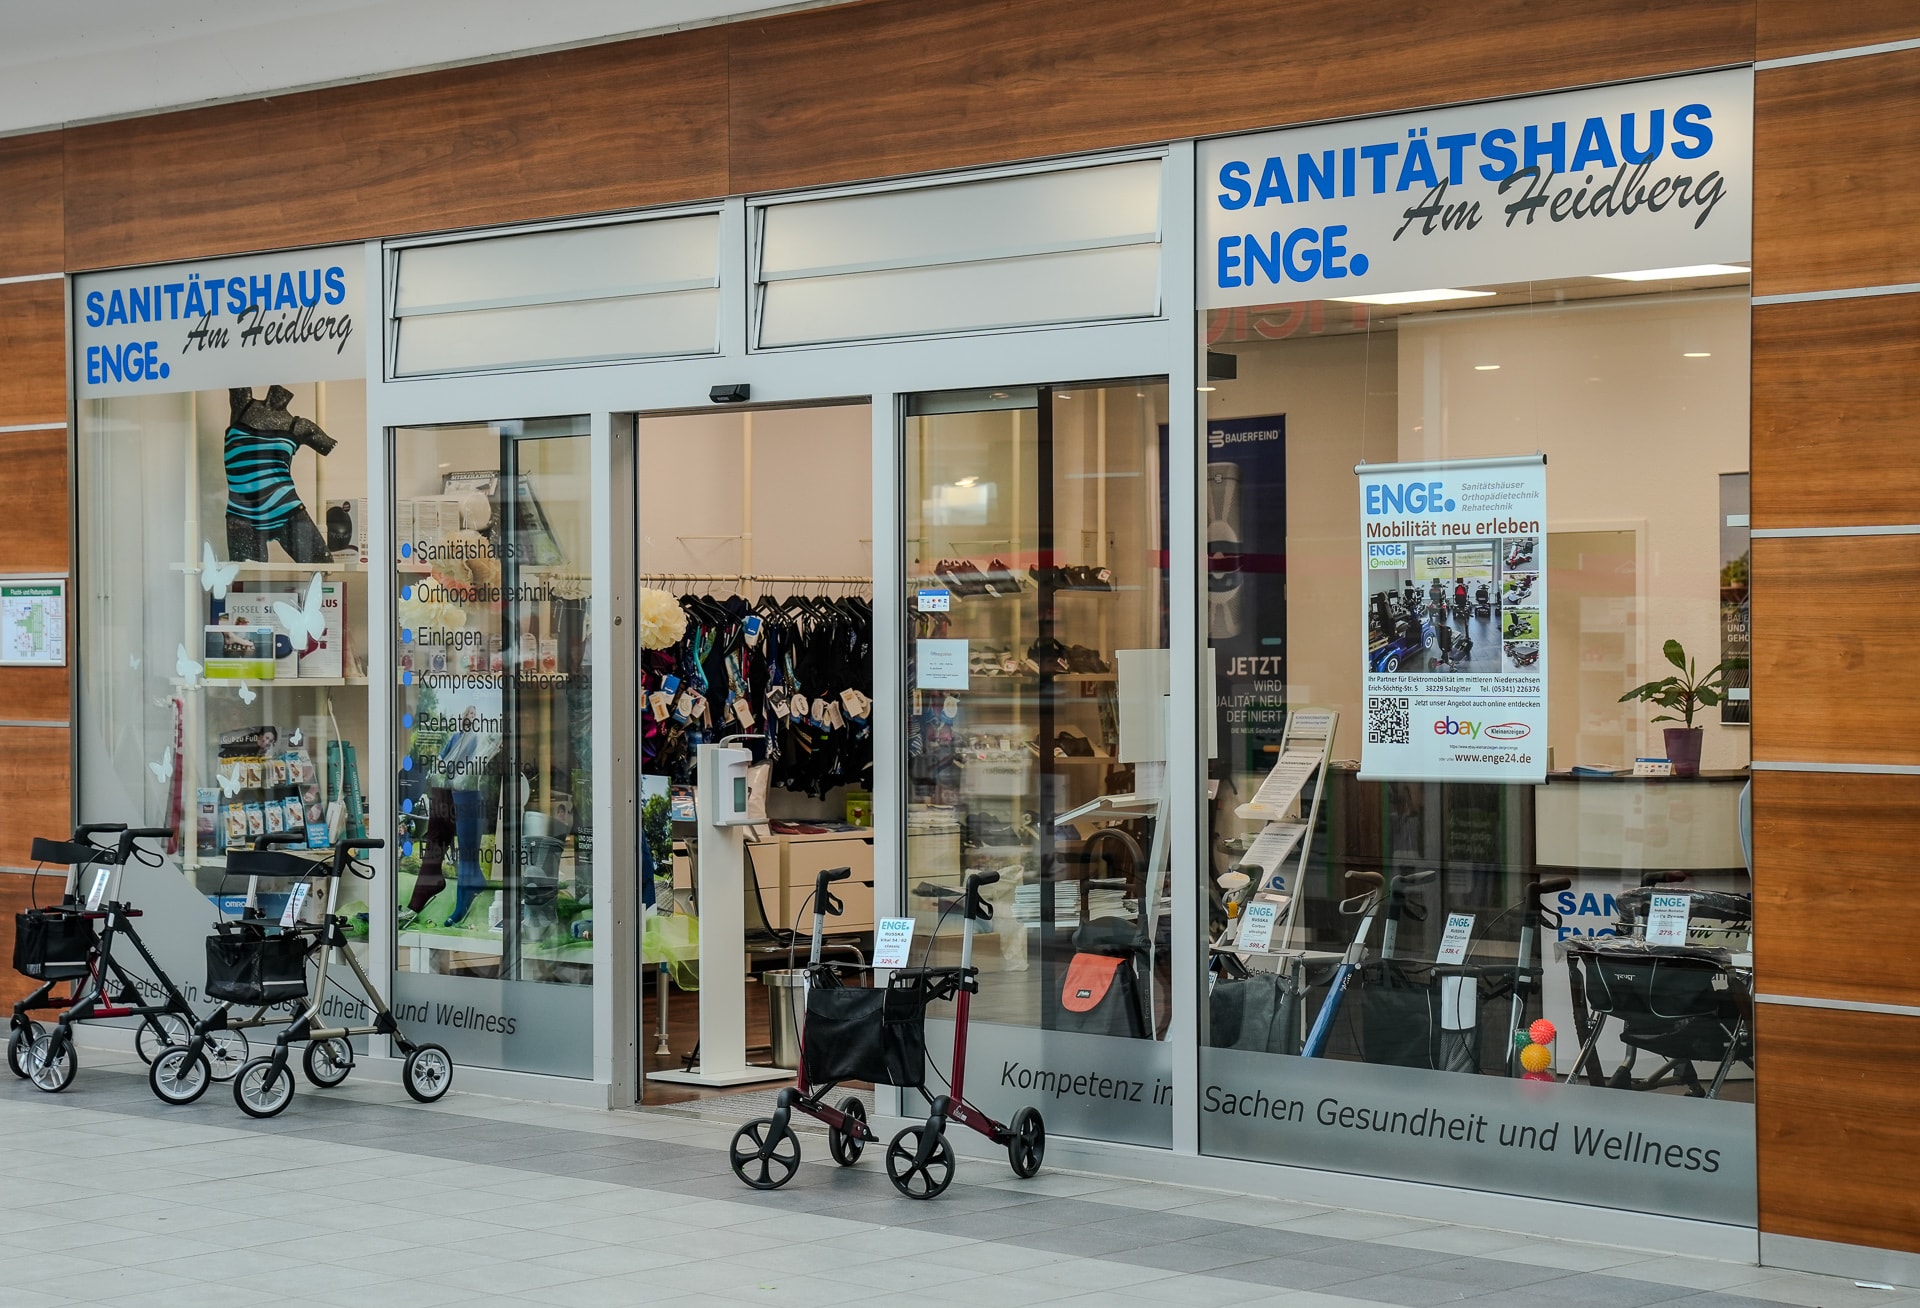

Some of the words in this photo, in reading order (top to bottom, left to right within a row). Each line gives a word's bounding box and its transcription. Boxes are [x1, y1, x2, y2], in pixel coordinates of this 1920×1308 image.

[1217, 103, 1714, 211] SANITÄTSHAUS
[1392, 176, 1482, 241] Am
[1497, 151, 1727, 230] Heidberg
[1217, 224, 1369, 288] ENGE.
[86, 266, 346, 327] SANITÄTSHAUS
[182, 310, 229, 354] Am
[237, 300, 353, 354] Heidberg
[86, 340, 170, 384] ENGE.
[1225, 430, 1279, 443] BAUERFEIND
[1461, 481, 1525, 491] Sanitätshäuser
[1461, 490, 1540, 502] Orthopädietechnik
[1366, 481, 1456, 515] ENGE.
[1461, 502, 1513, 512] Rehatechnik
[1366, 520, 1437, 538] Mobilität
[1442, 522, 1471, 536] neu
[1475, 517, 1540, 534] erleben
[417, 581, 555, 607] Orthopädietechnik
[232, 605, 259, 614] SISSEL
[1727, 624, 1745, 632] UND
[418, 626, 482, 651] Einlagen
[1226, 656, 1282, 676] JETZT
[1253, 680, 1282, 692] WIRD
[1377, 675, 1397, 683] Partner
[1399, 675, 1407, 683] für
[1408, 675, 1455, 683] Elektromobilität
[1494, 676, 1541, 684] Niedersachsen
[1444, 685, 1471, 694] Salzgitter
[1492, 685, 1516, 694] (05341)
[1516, 685, 1540, 693] 226376
[1216, 692, 1256, 707] UALITÄT
[1260, 695, 1282, 707] NEU
[1447, 700, 1472, 708] Angebot
[1226, 710, 1283, 723] DEFINIERT
[1433, 716, 1482, 740] ebay
[1490, 728, 1525, 736] Kleinanzeigen
[1454, 753, 1532, 765] www.enge24.de
[184, 980, 197, 1002] in
[395, 1001, 430, 1023] und
[436, 1003, 517, 1035] Wellness
[1001, 1061, 1143, 1102] Kompetenz
[1153, 1078, 1172, 1106] in
[1203, 1085, 1304, 1122] Sachen
[1316, 1098, 1488, 1143] Gesundheit
[1499, 1122, 1559, 1151] und
[1574, 1125, 1721, 1173] Wellness
